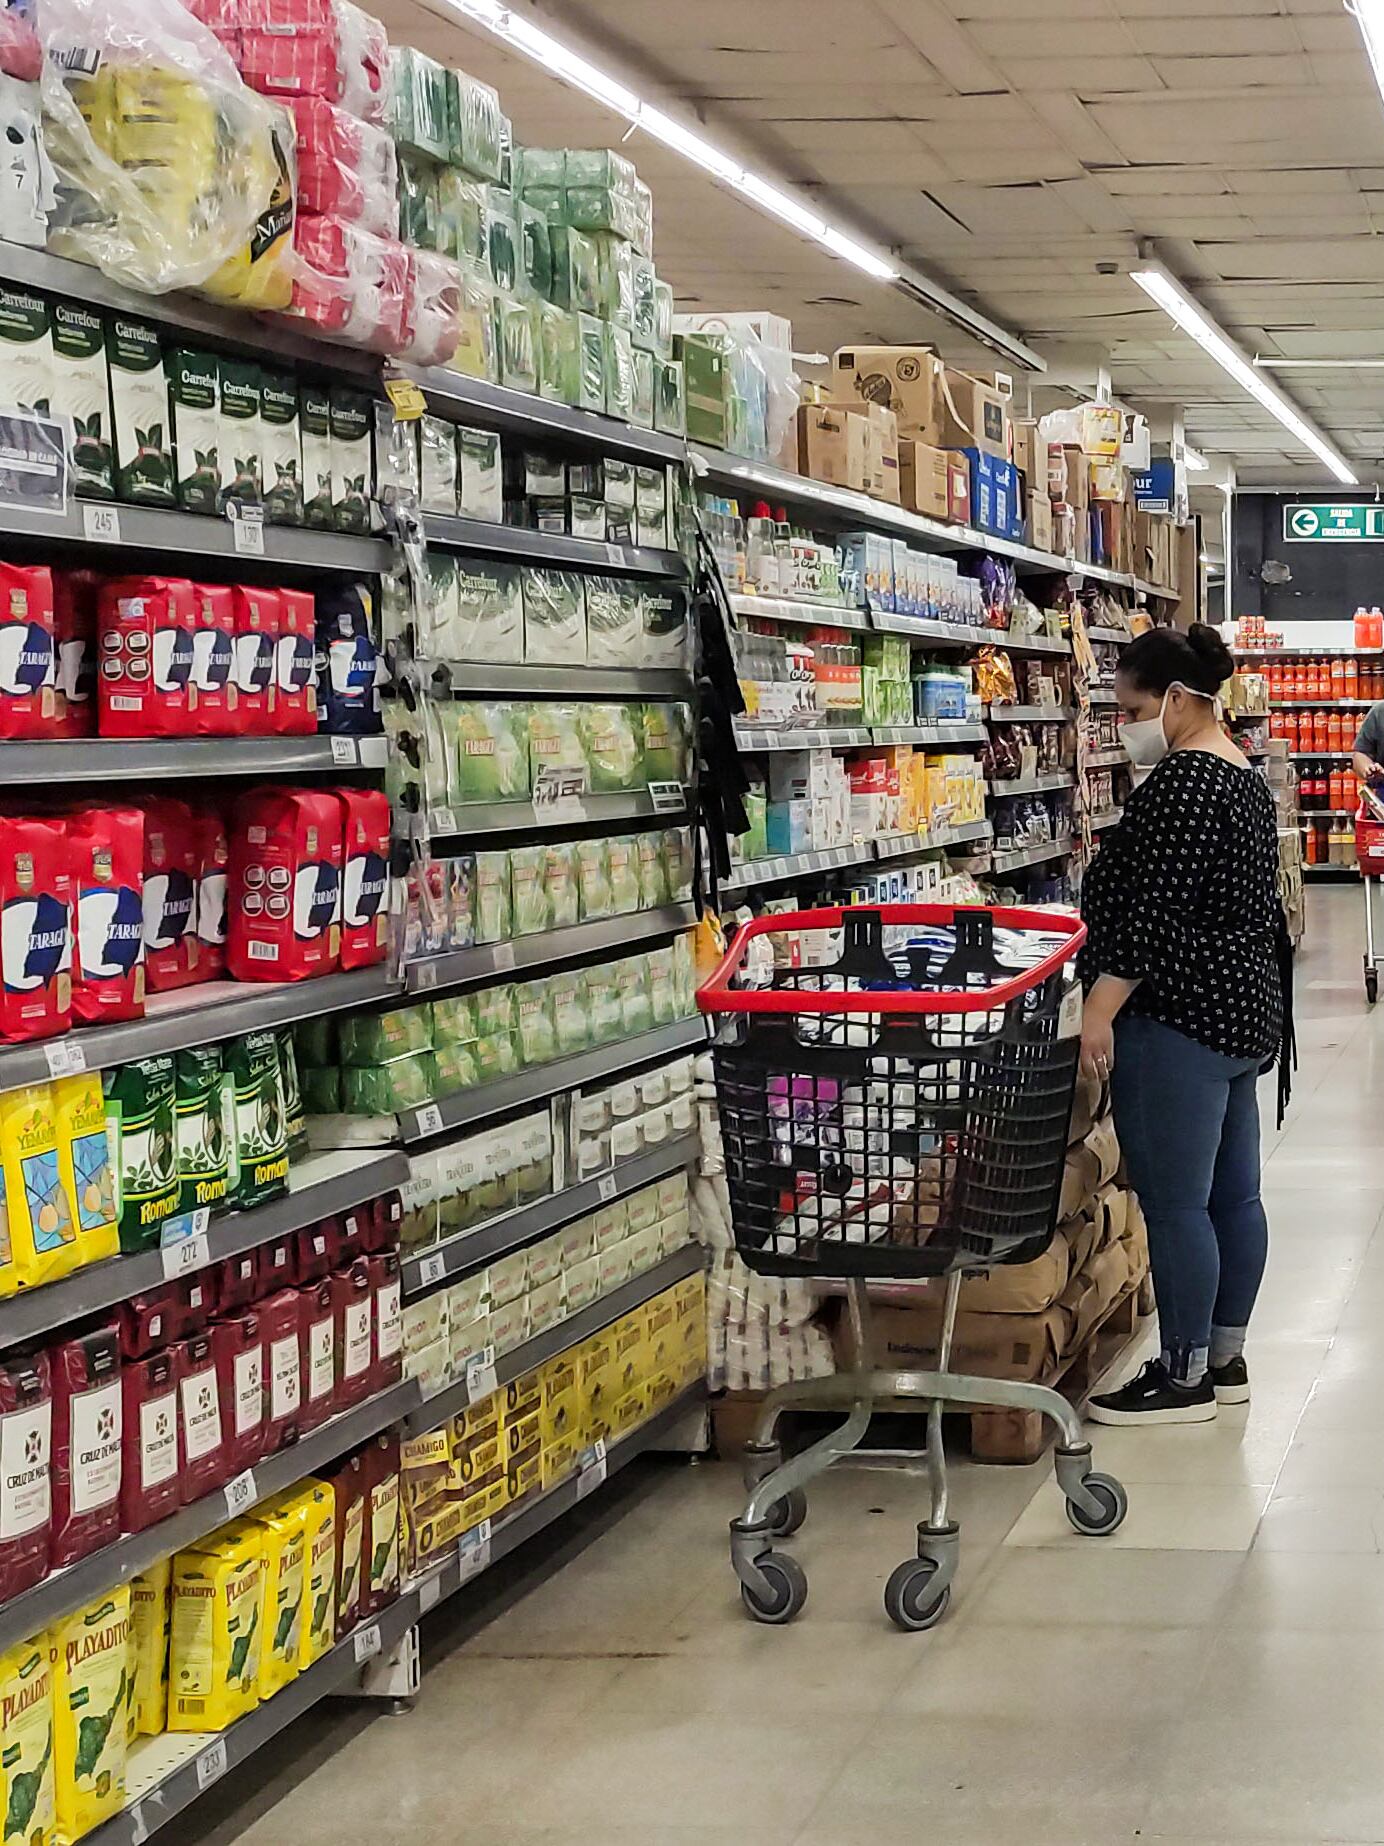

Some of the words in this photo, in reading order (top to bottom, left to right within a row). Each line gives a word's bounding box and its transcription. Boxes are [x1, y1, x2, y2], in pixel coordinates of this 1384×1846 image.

[56, 305, 101, 330] Carrefour
[115, 322, 158, 344] Carrefour
[80, 1451, 100, 1465] CRUZ
[7, 1473, 27, 1489] CRUZ
[65, 1624, 128, 1677] PLAYADITO
